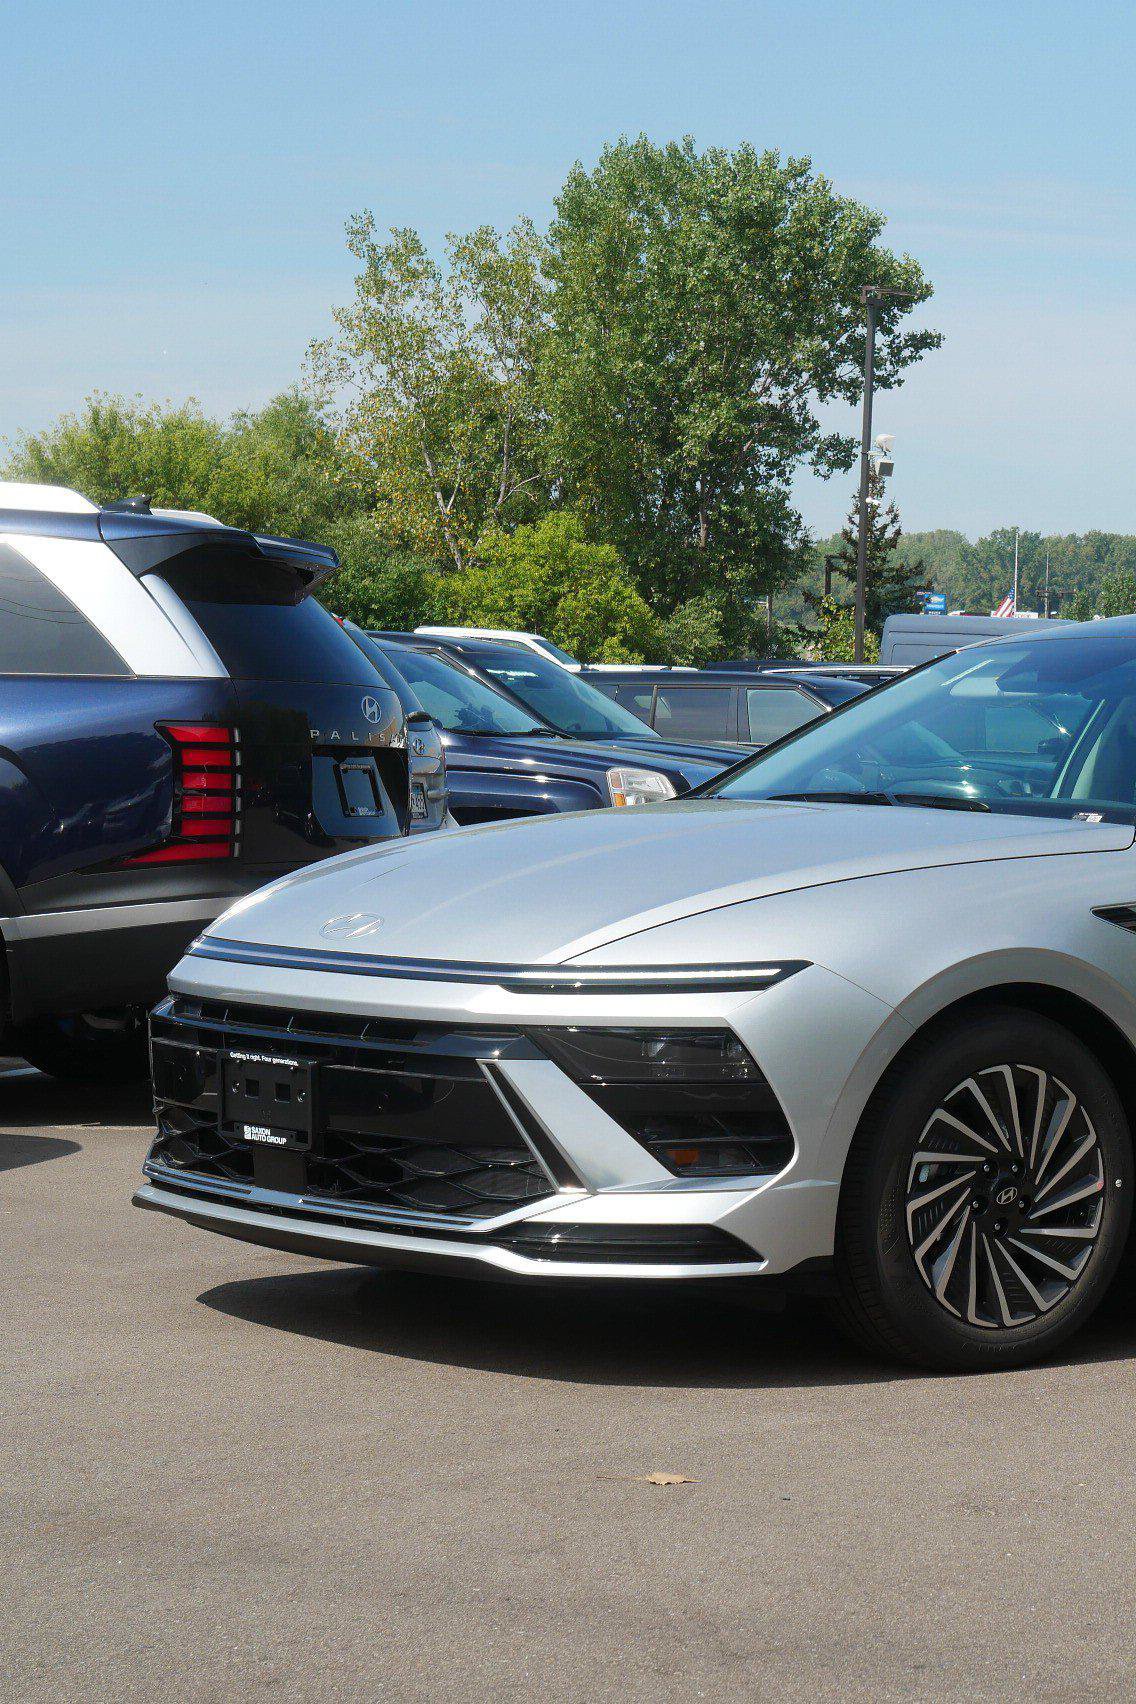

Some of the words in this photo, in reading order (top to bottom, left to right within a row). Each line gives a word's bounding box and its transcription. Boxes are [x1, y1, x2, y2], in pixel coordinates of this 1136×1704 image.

[309, 729, 405, 748] PALIS
[230, 1052, 246, 1060] Getting
[261, 1055, 272, 1063] Four
[272, 1058, 298, 1066] generations.
[251, 1126, 270, 1135] SAXON
[251, 1133, 267, 1142] AUTO
[266, 1135, 287, 1145] GROUP
